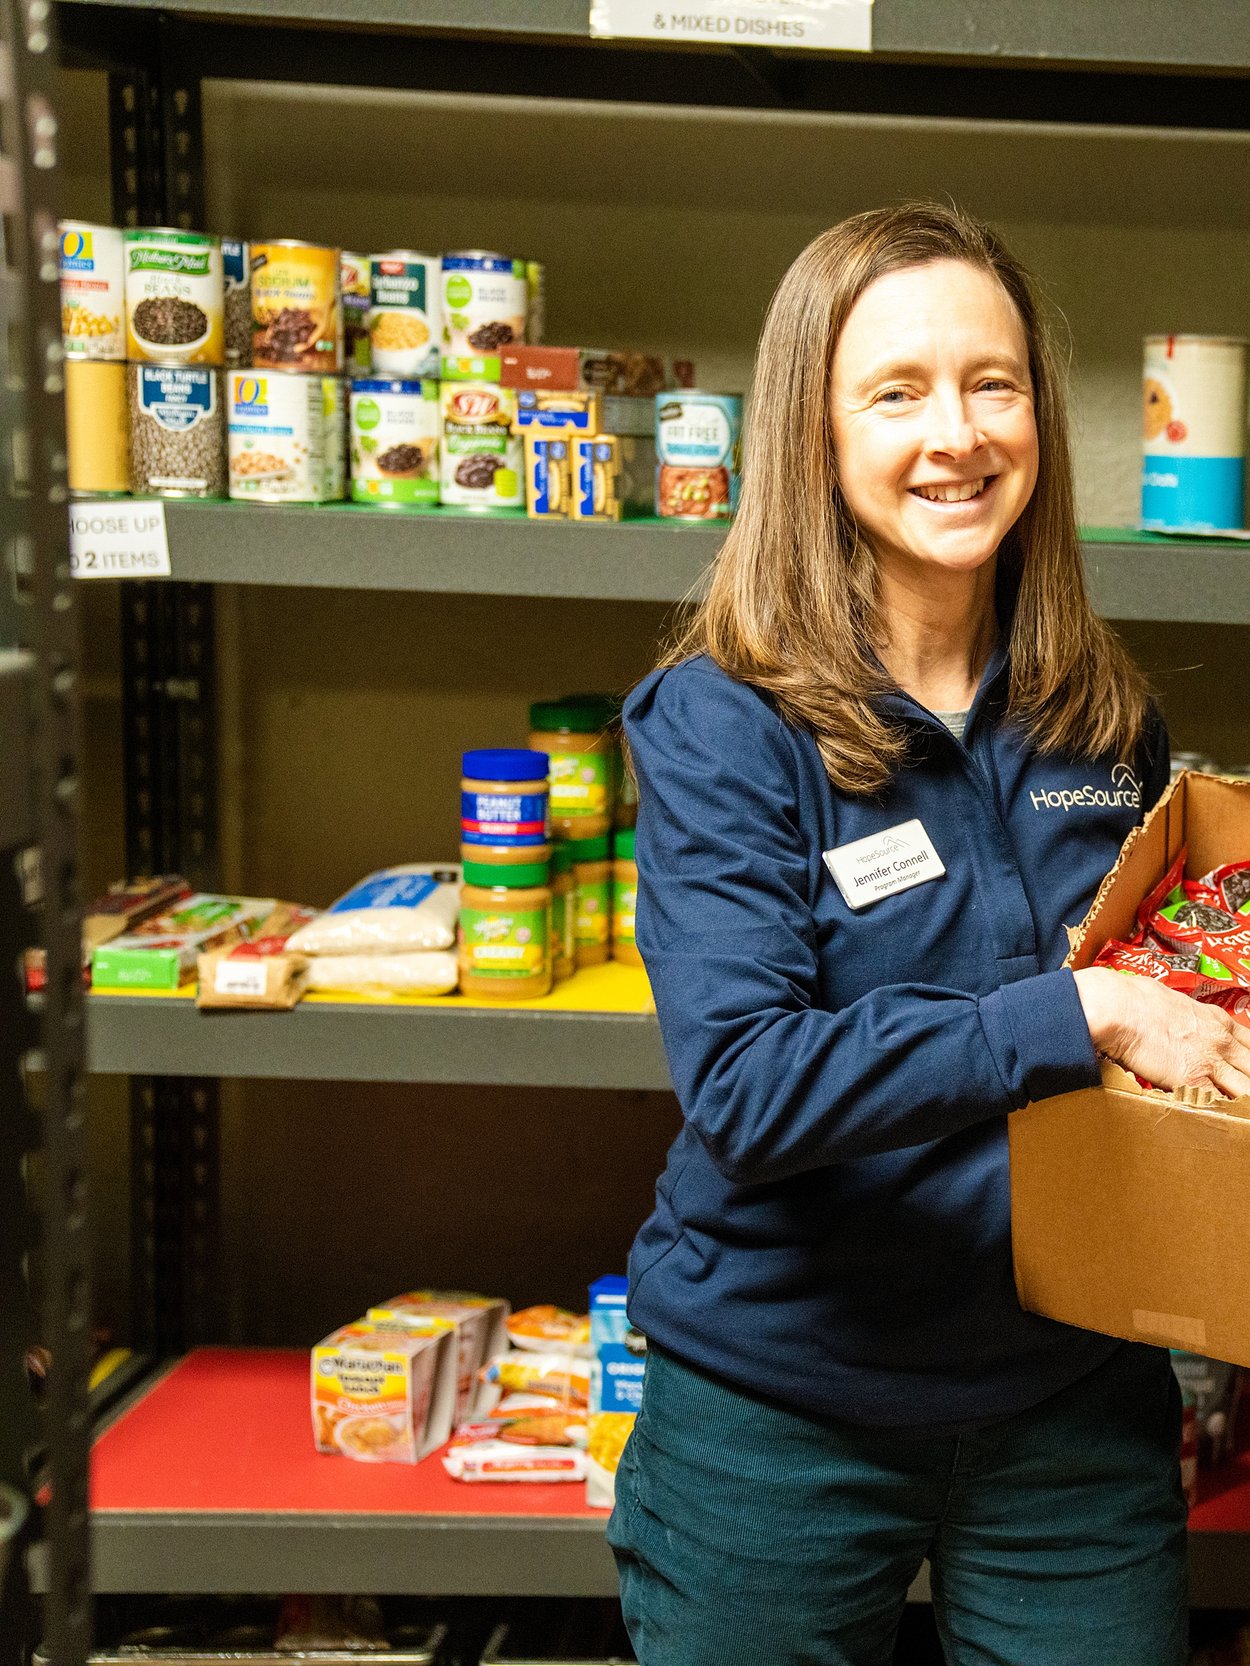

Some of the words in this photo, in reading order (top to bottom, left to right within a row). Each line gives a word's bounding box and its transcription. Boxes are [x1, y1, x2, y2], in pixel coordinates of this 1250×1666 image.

[653, 14, 666, 30] &
[671, 15, 730, 33] MIXED
[734, 17, 806, 38] DISHES
[143, 369, 173, 382] BLACK
[688, 427, 719, 444] FREE
[71, 516, 129, 536] OOSE
[134, 516, 160, 534] UP
[84, 551, 97, 569] 2
[102, 551, 160, 569] ITEMS
[1029, 785, 1141, 812] HopeSource
[856, 843, 899, 864] HopeSource
[853, 866, 891, 888] Jennifer
[892, 849, 929, 872] Connell
[874, 878, 897, 892] Program
[896, 869, 921, 883] Manager
